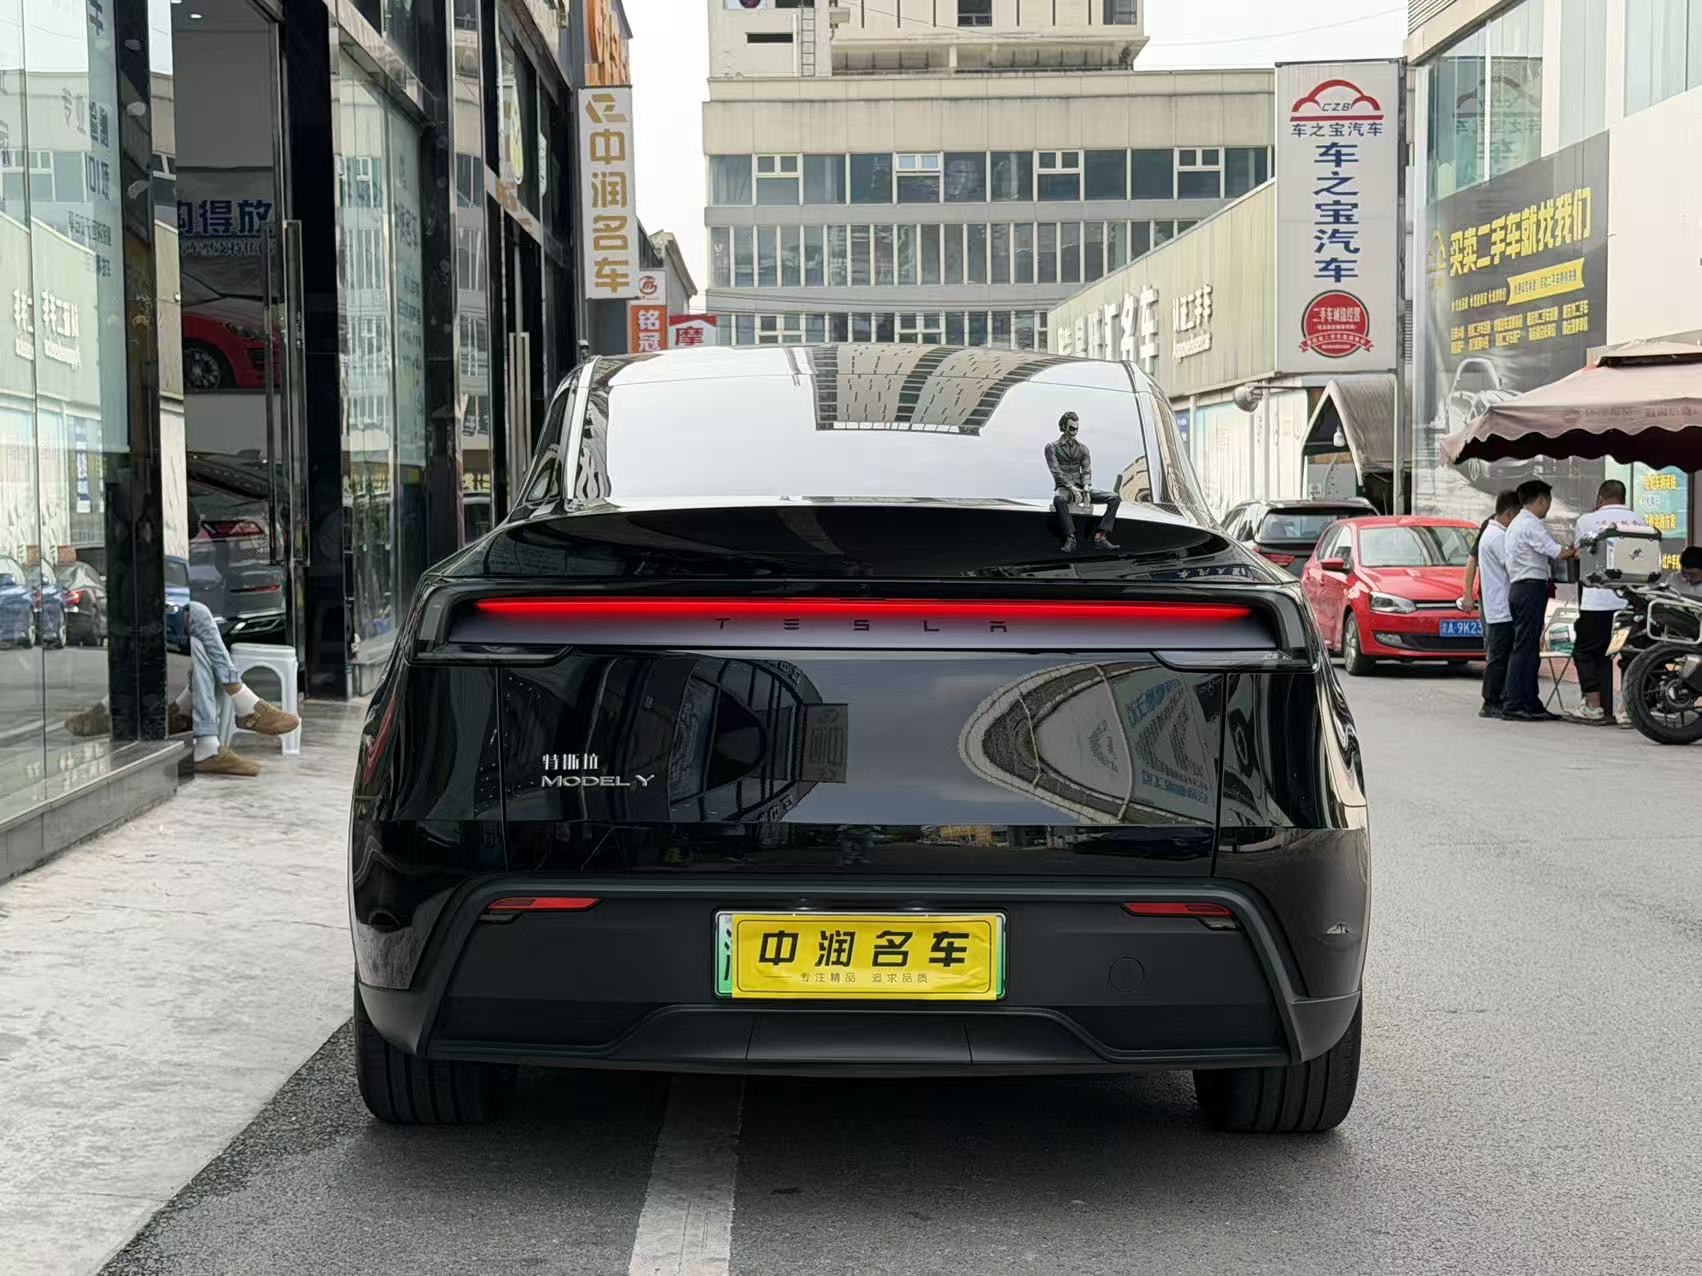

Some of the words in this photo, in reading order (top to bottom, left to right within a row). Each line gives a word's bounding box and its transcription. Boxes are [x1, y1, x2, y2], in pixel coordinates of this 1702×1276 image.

[1322, 102, 1350, 112] CZB
[1291, 122, 1383, 137] 车之宝汽车
[590, 128, 630, 293] 中润名车
[1313, 142, 1360, 283] 车之宝汽车
[1449, 188, 1591, 276] 买卖二手车就找我们
[675, 326, 704, 346] 摩
[715, 618, 1007, 632] TESLA
[542, 753, 599, 771] 特斯拉
[541, 775, 630, 787] MODEL
[635, 774, 655, 787] Y
[758, 930, 970, 967] 中润名车
[800, 972, 856, 983] 专注精品
[872, 972, 928, 984] 追求品质
